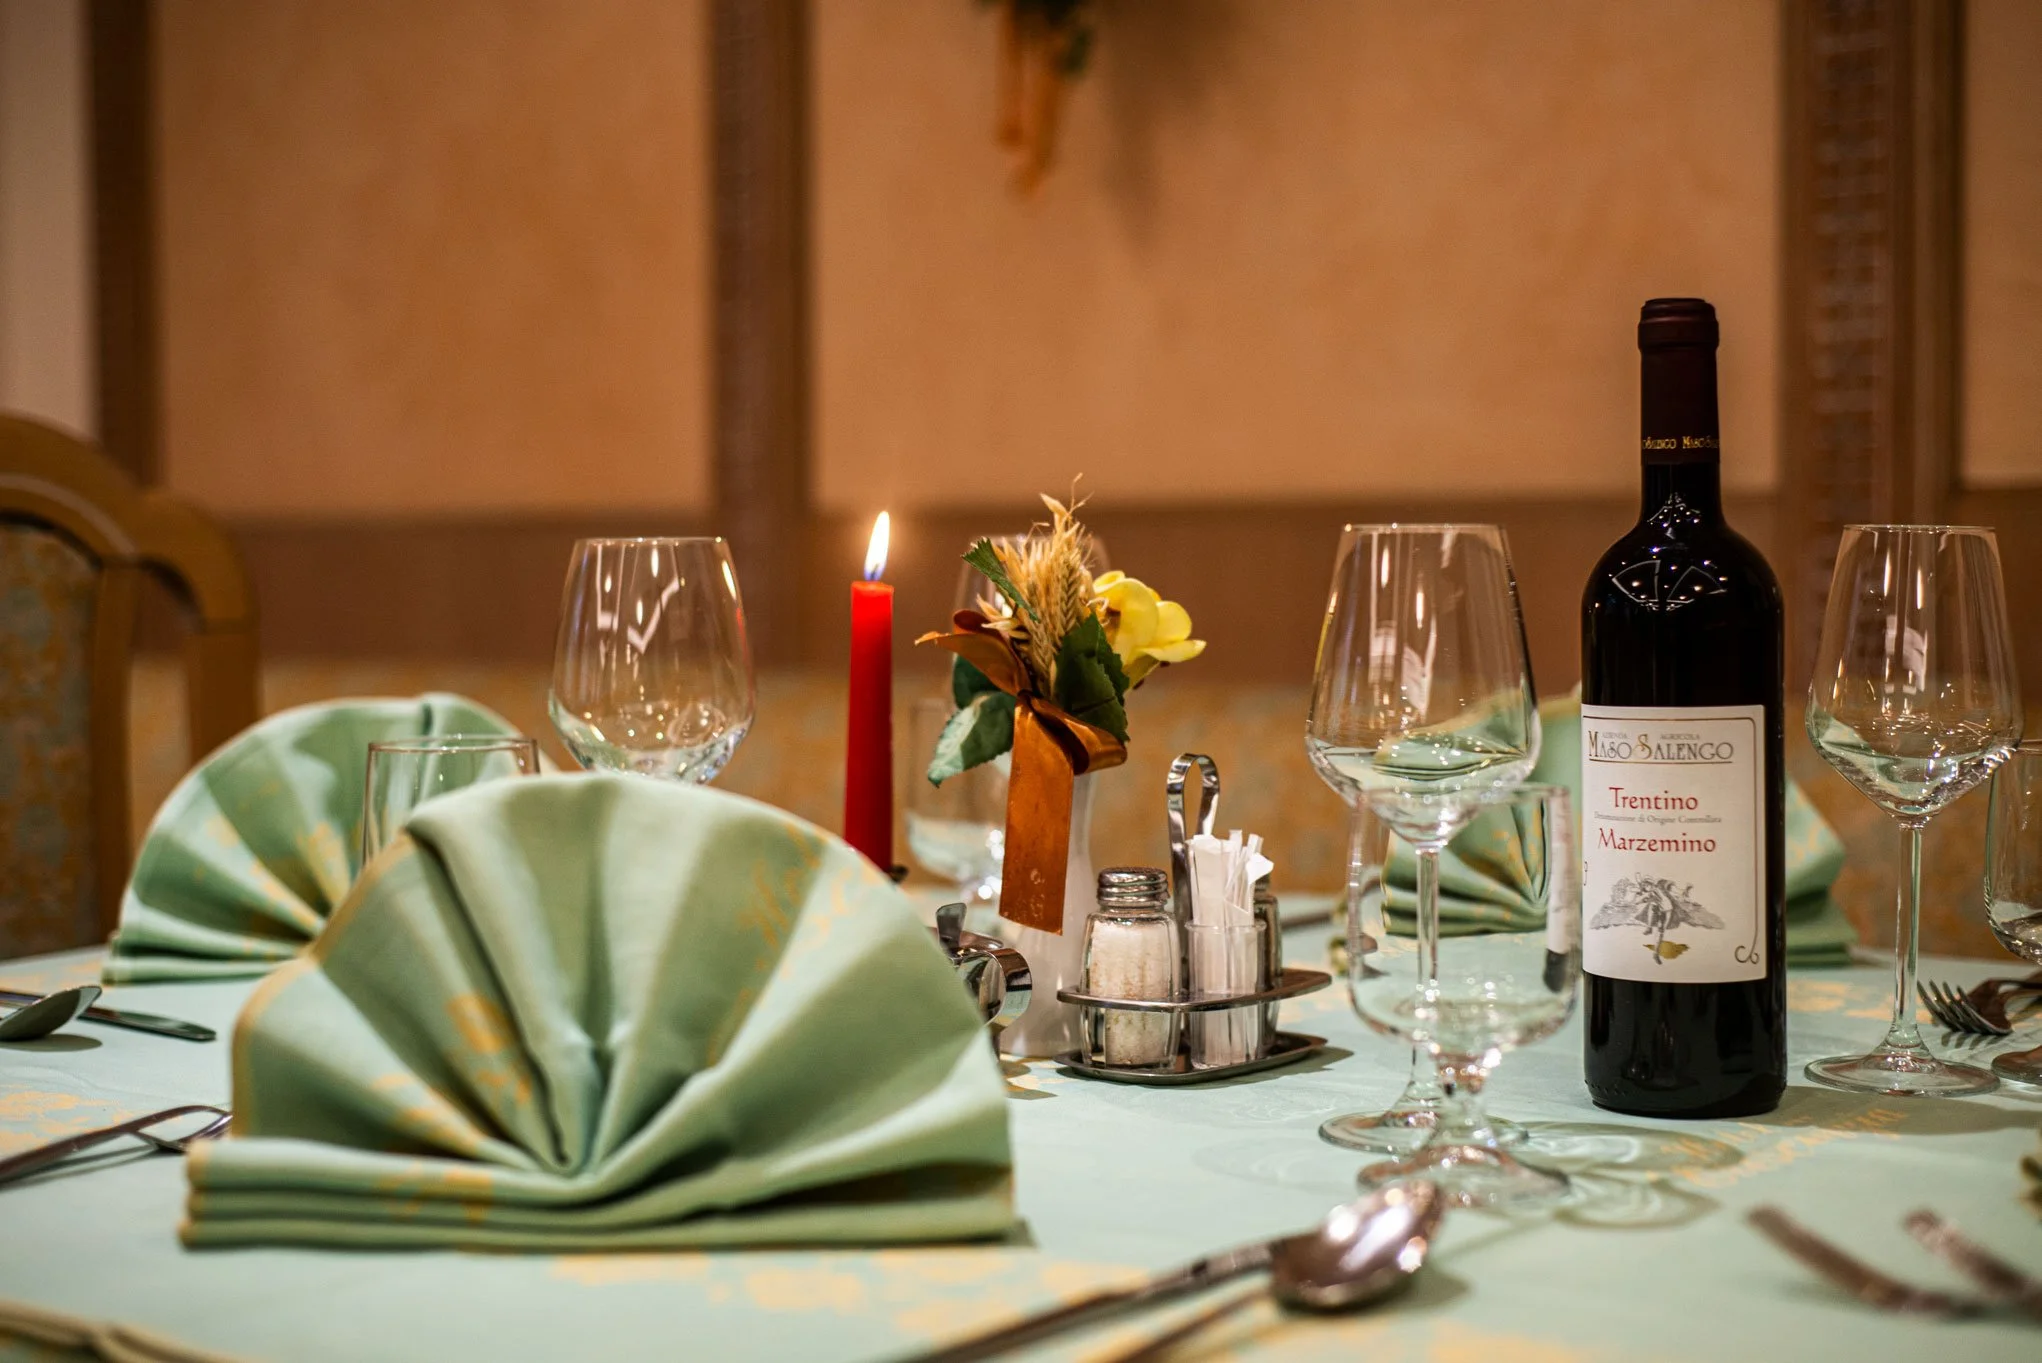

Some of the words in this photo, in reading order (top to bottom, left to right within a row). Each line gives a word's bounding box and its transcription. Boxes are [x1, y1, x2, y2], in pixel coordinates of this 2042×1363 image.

[1588, 730, 1633, 760] MASO
[1634, 733, 1734, 761] SALENGO
[1609, 786, 1699, 811] Trentino
[1598, 827, 1717, 853] Marzemino
